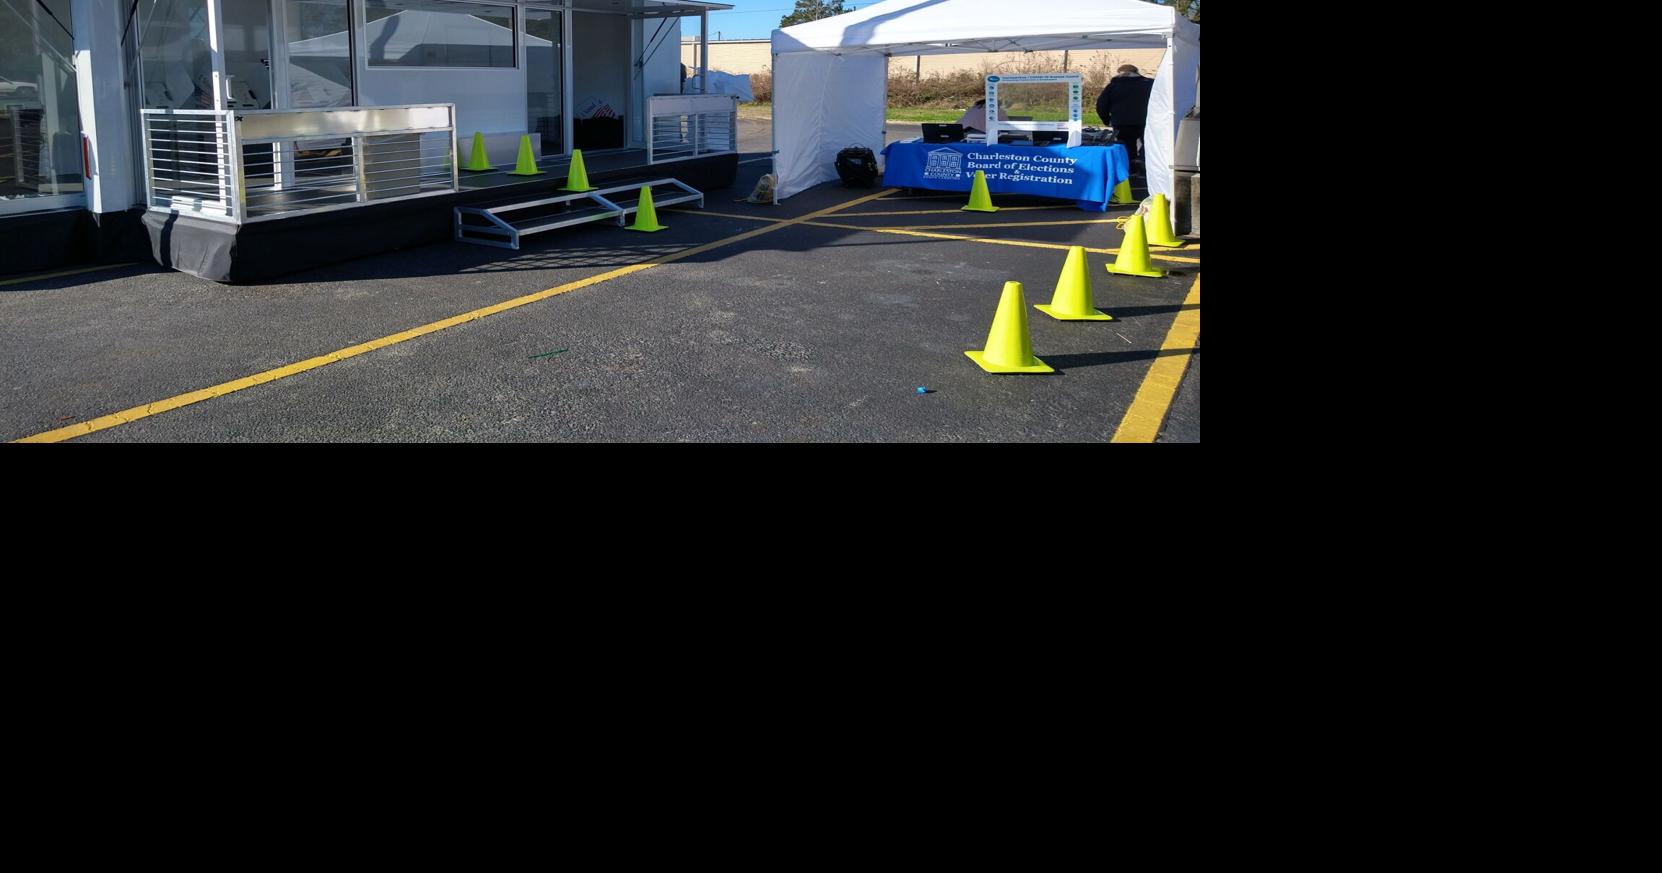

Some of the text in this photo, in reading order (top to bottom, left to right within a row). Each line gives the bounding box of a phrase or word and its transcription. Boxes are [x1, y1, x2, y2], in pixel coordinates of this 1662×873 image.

[967, 152, 1078, 165] Charleston County
[967, 161, 1001, 169] Board
[1019, 164, 1075, 173] Elections
[999, 172, 1073, 184] Registration
